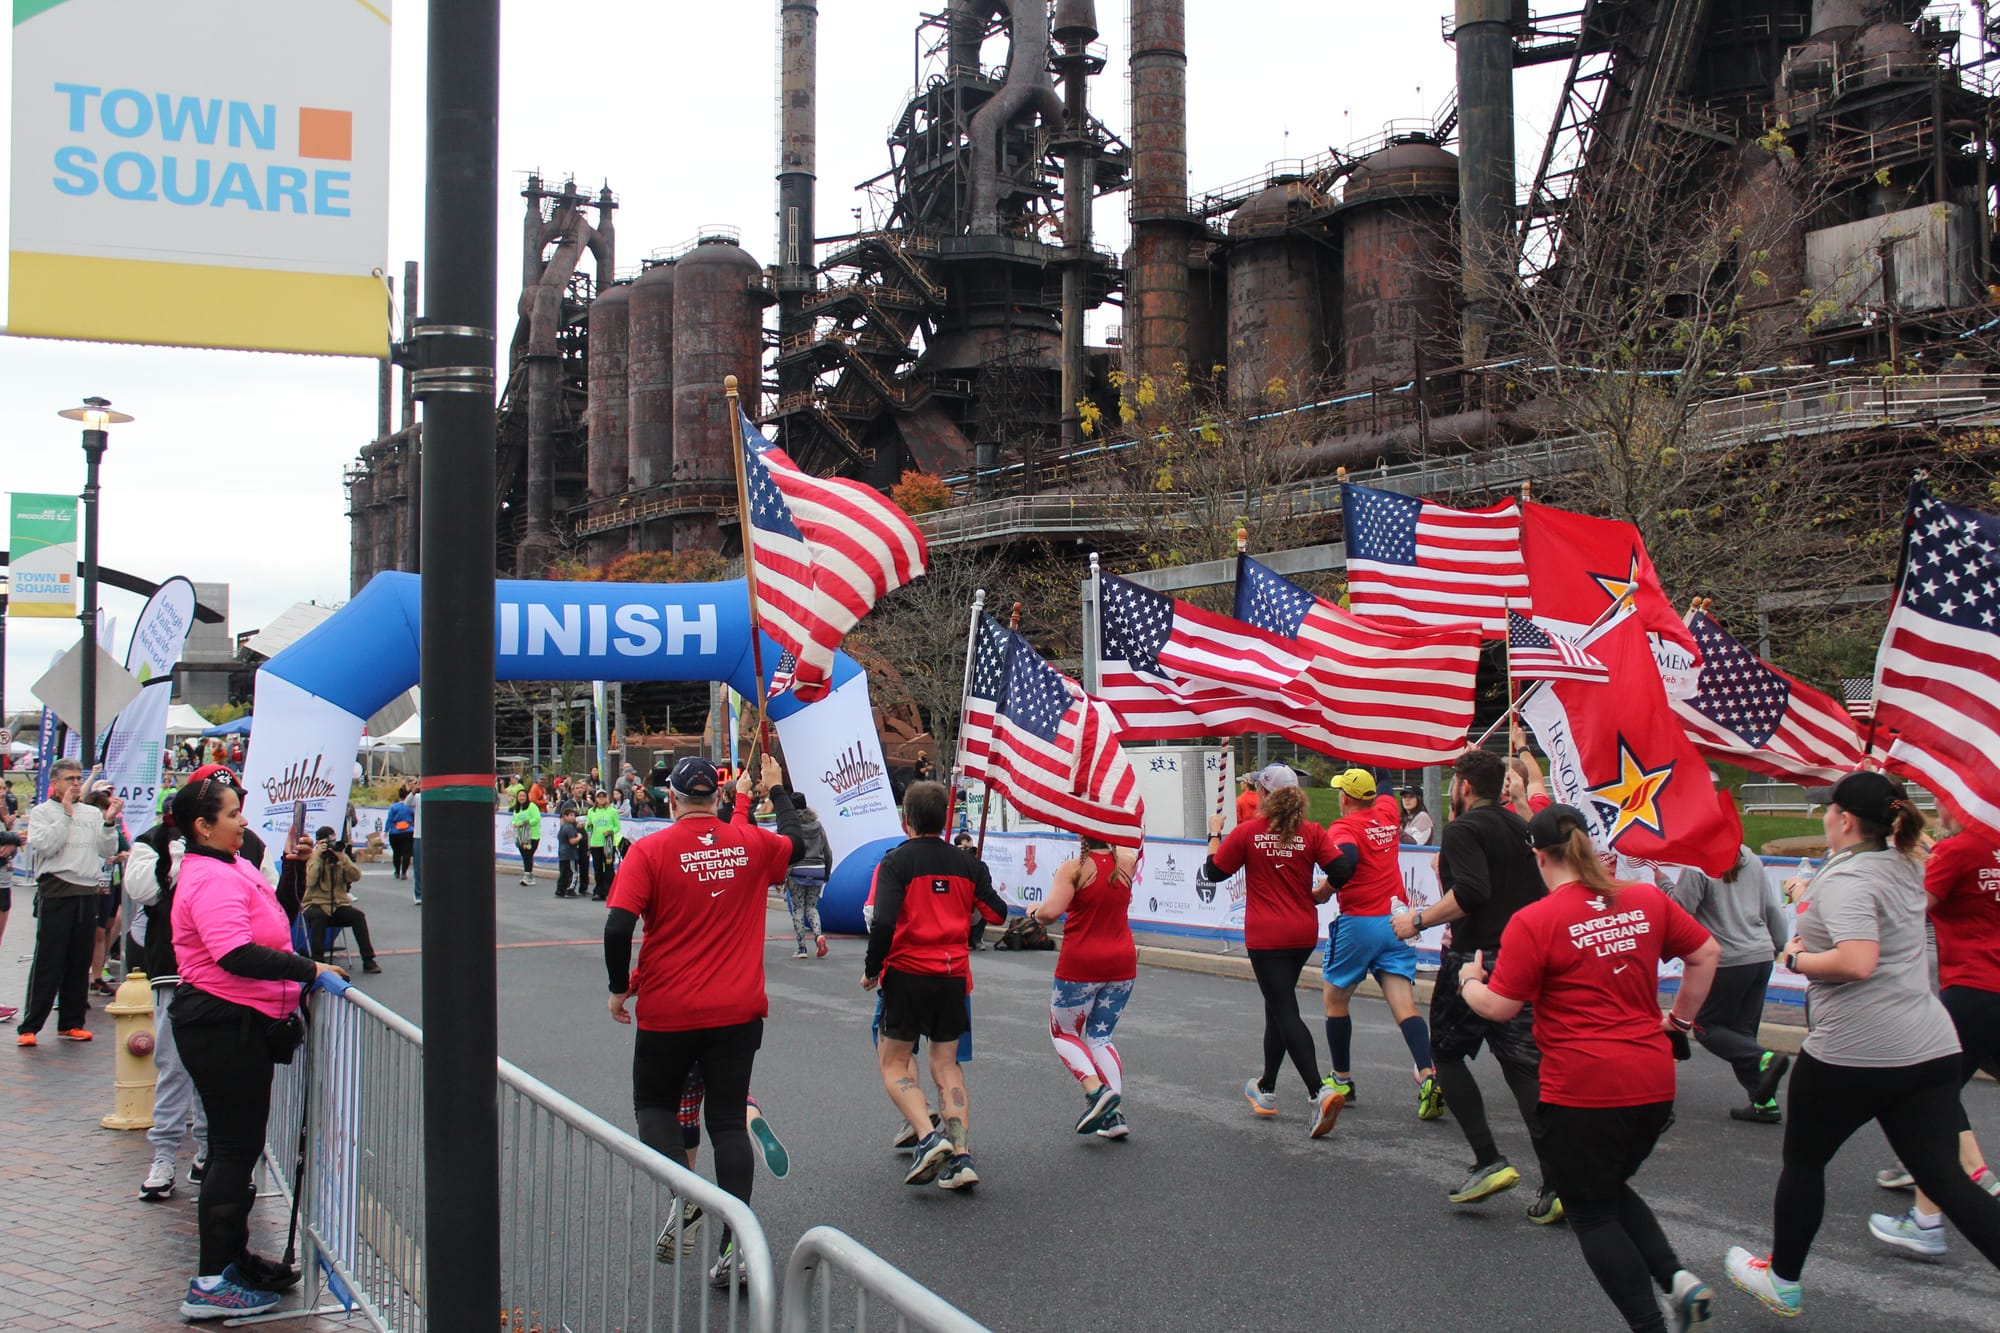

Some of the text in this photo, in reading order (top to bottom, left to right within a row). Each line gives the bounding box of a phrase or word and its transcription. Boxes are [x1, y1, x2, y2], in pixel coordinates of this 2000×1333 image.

[54, 82, 276, 151] TOWN
[53, 146, 351, 217] SQUARE
[16, 572, 56, 583] TOWN
[16, 583, 70, 594] SQUARE
[155, 608, 176, 641] Valley
[160, 594, 184, 631] Lehigh
[500, 603, 718, 656] INISH
[820, 740, 884, 794] Bethlehem
[1548, 720, 1580, 801] HONOR
[262, 754, 336, 804] Bethlehem
[680, 846, 746, 863] ENRICHING
[680, 857, 749, 873] VETERANS'
[1266, 849, 1293, 858] LIVES
[698, 869, 735, 882] LIVES
[1017, 884, 1043, 902] ucan
[1568, 910, 1645, 937] ENRICHING
[1595, 938, 1637, 957] LIVES
